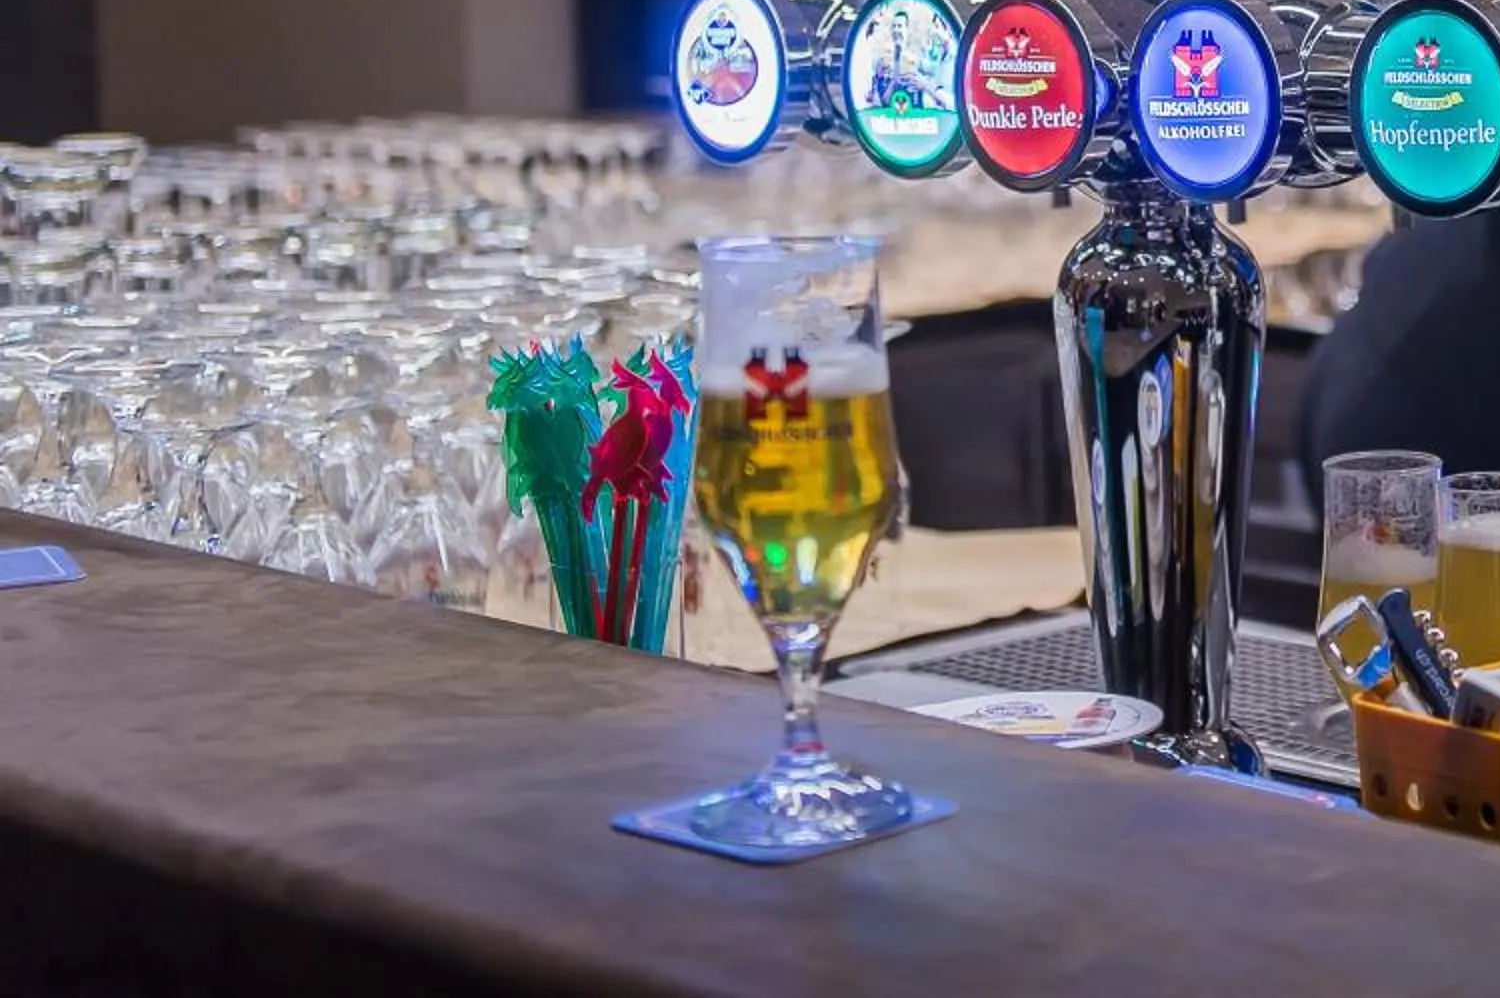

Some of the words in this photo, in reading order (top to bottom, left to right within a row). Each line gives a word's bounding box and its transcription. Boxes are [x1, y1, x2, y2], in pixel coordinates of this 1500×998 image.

[1384, 69, 1472, 84] FELDSCHLÖSSCHEN
[1149, 98, 1249, 116] FELDSCHLÖSSCHEN
[968, 104, 1027, 129] Dunkle
[1031, 104, 1077, 129] Perle
[1159, 123, 1245, 139] ALKOHOLFREI
[1369, 119, 1496, 152] Hopfenperle
